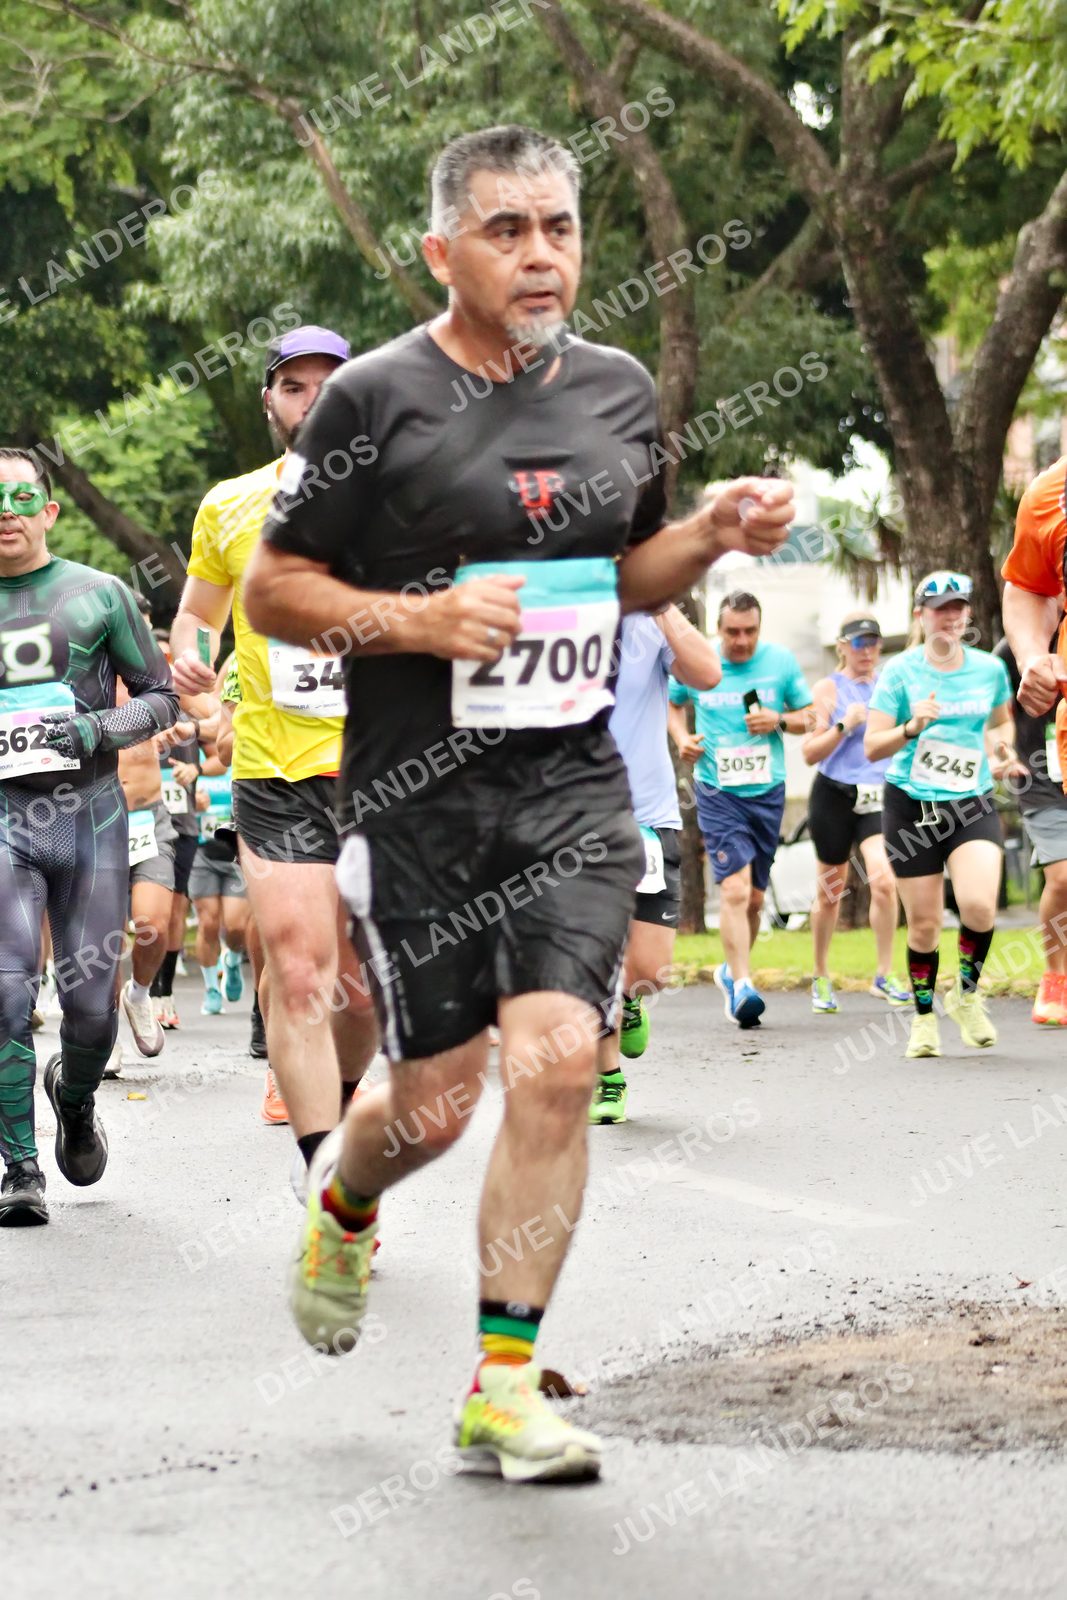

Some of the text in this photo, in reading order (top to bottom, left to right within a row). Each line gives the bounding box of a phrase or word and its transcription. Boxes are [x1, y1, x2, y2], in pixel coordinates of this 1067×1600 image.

[469, 634, 602, 687] 2700
[719, 755, 767, 773] 3057
[919, 751, 977, 779] 4245
